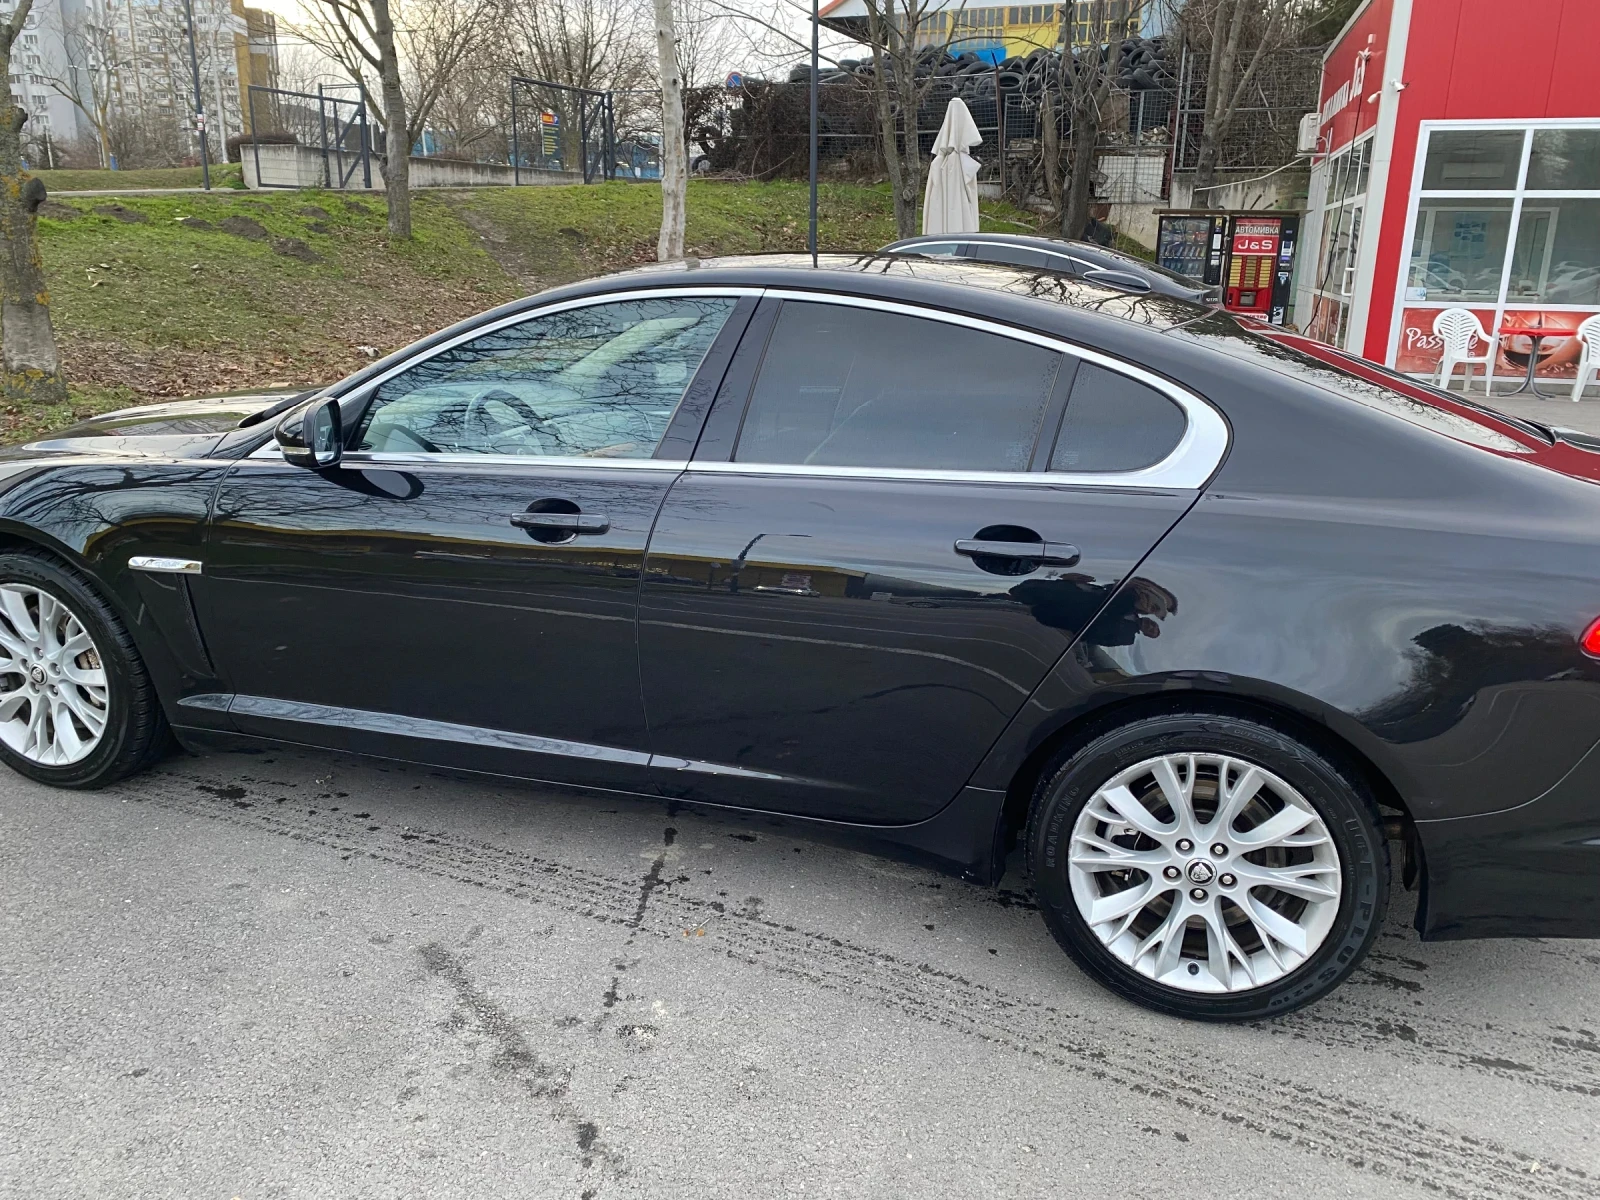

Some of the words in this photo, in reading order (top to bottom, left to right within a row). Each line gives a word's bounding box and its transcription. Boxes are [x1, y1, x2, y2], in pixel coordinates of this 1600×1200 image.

[1235, 226, 1279, 234] АВТОМИВКА
[1238, 239, 1273, 250] J&S
[1045, 785, 1080, 868] ROADKING
